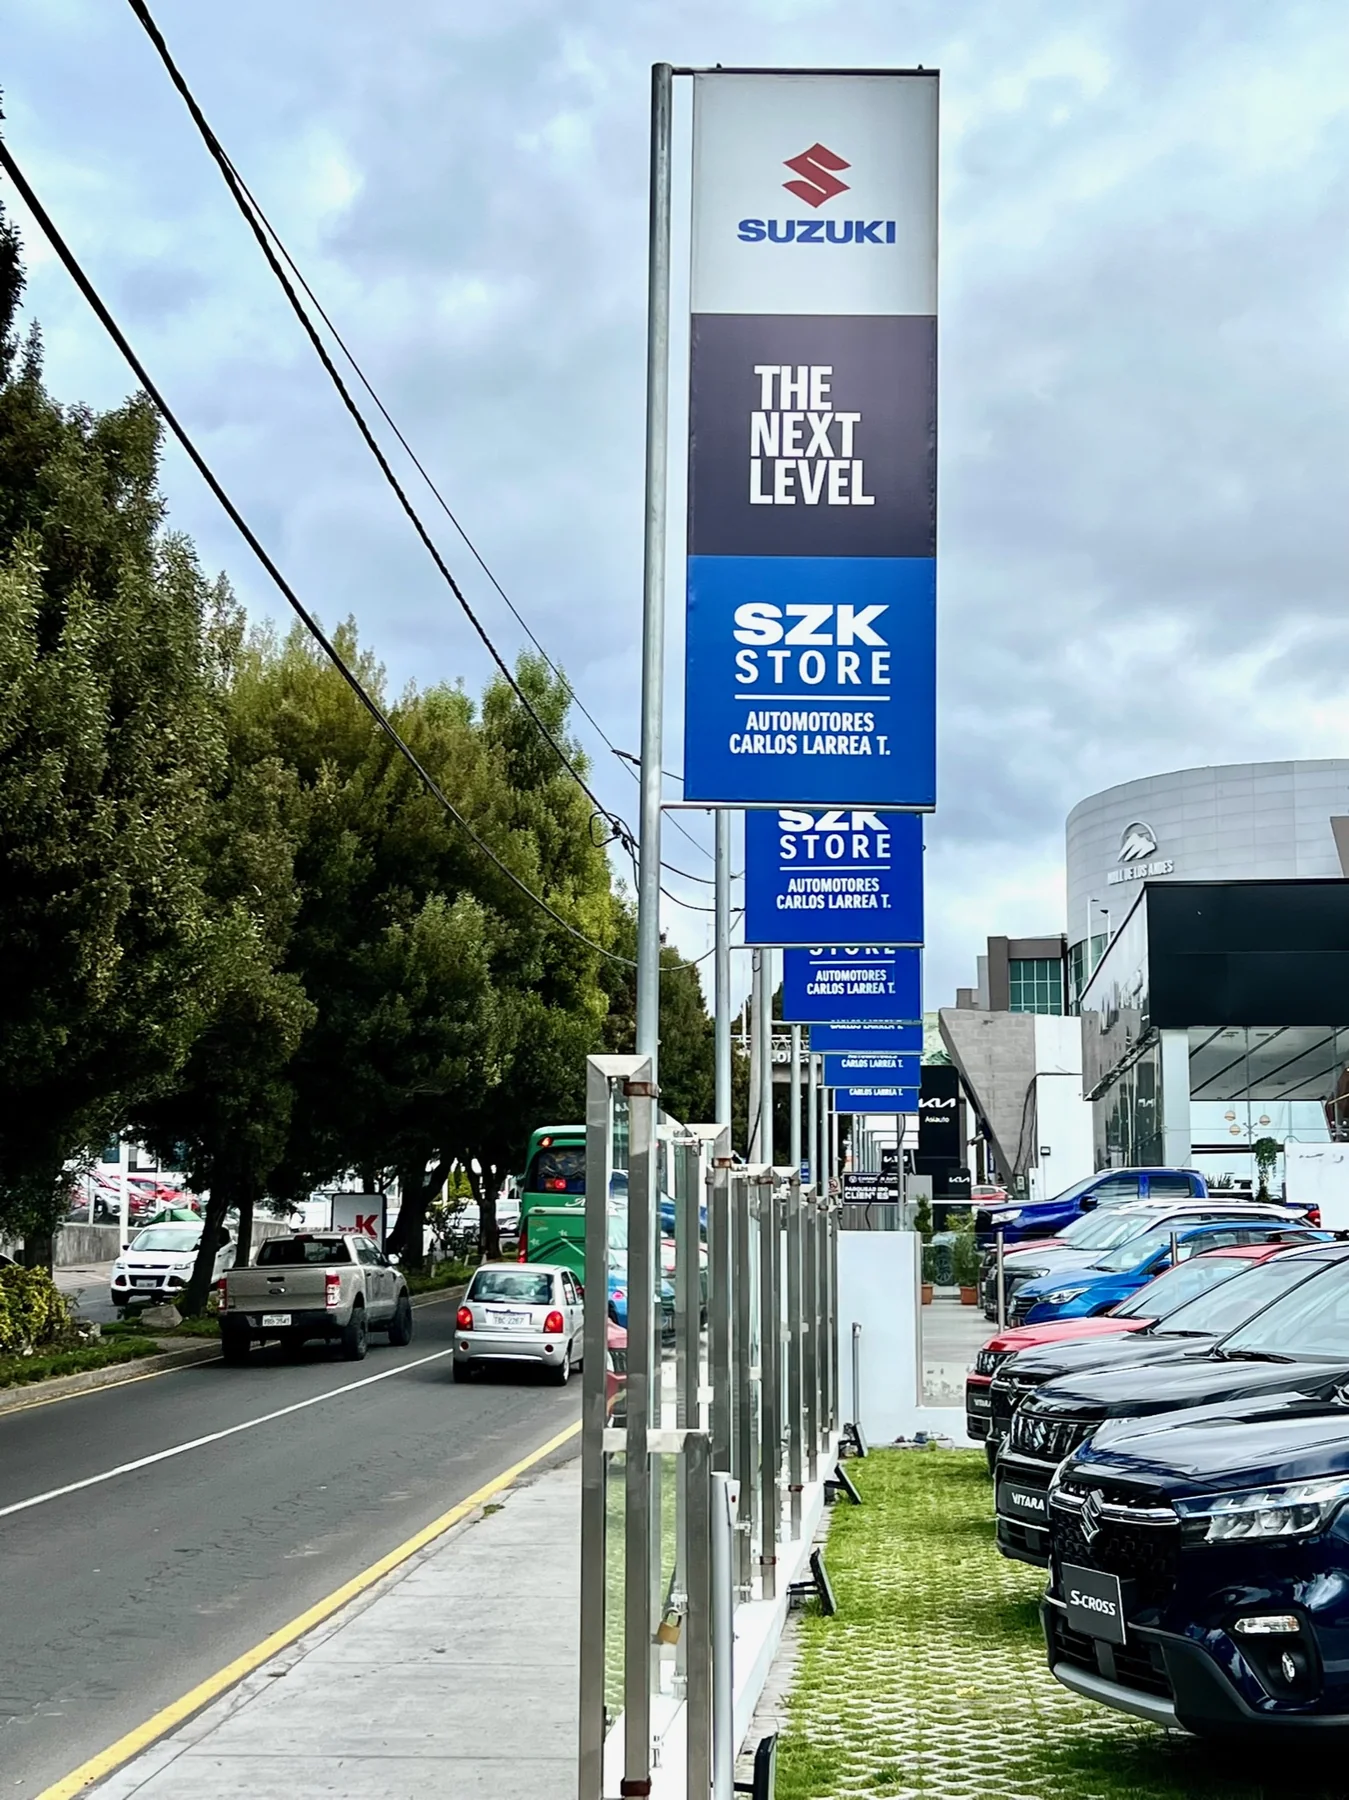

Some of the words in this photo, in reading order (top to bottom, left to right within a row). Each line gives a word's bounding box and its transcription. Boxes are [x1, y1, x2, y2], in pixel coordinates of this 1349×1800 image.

[737, 219, 896, 244] SUZUKI
[754, 365, 833, 410] THE
[751, 411, 861, 457] NEXT
[750, 459, 875, 505] LEVEL
[733, 602, 890, 646] SZK
[735, 649, 891, 685] STORE
[745, 711, 875, 732] AUTOMOTORES
[729, 733, 797, 755] CARLOS
[803, 735, 872, 755] LARREA
[877, 736, 891, 756] T.
[778, 809, 889, 832] SZK
[780, 834, 891, 859] STORE
[788, 878, 880, 893] AUTOMOTORES
[776, 894, 825, 910] CARLOS
[828, 894, 878, 909] LARREA
[881, 894, 892, 909] T.
[815, 969, 887, 982] AUTOMOTORES
[806, 983, 845, 995] CARLOS
[847, 983, 885, 994] LARREA
[887, 982, 896, 994] T.
[841, 1059, 868, 1068] CARLOS
[869, 1059, 896, 1068] LARREA
[918, 1097, 957, 1108] KIA
[1011, 1491, 1045, 1511] VITARA
